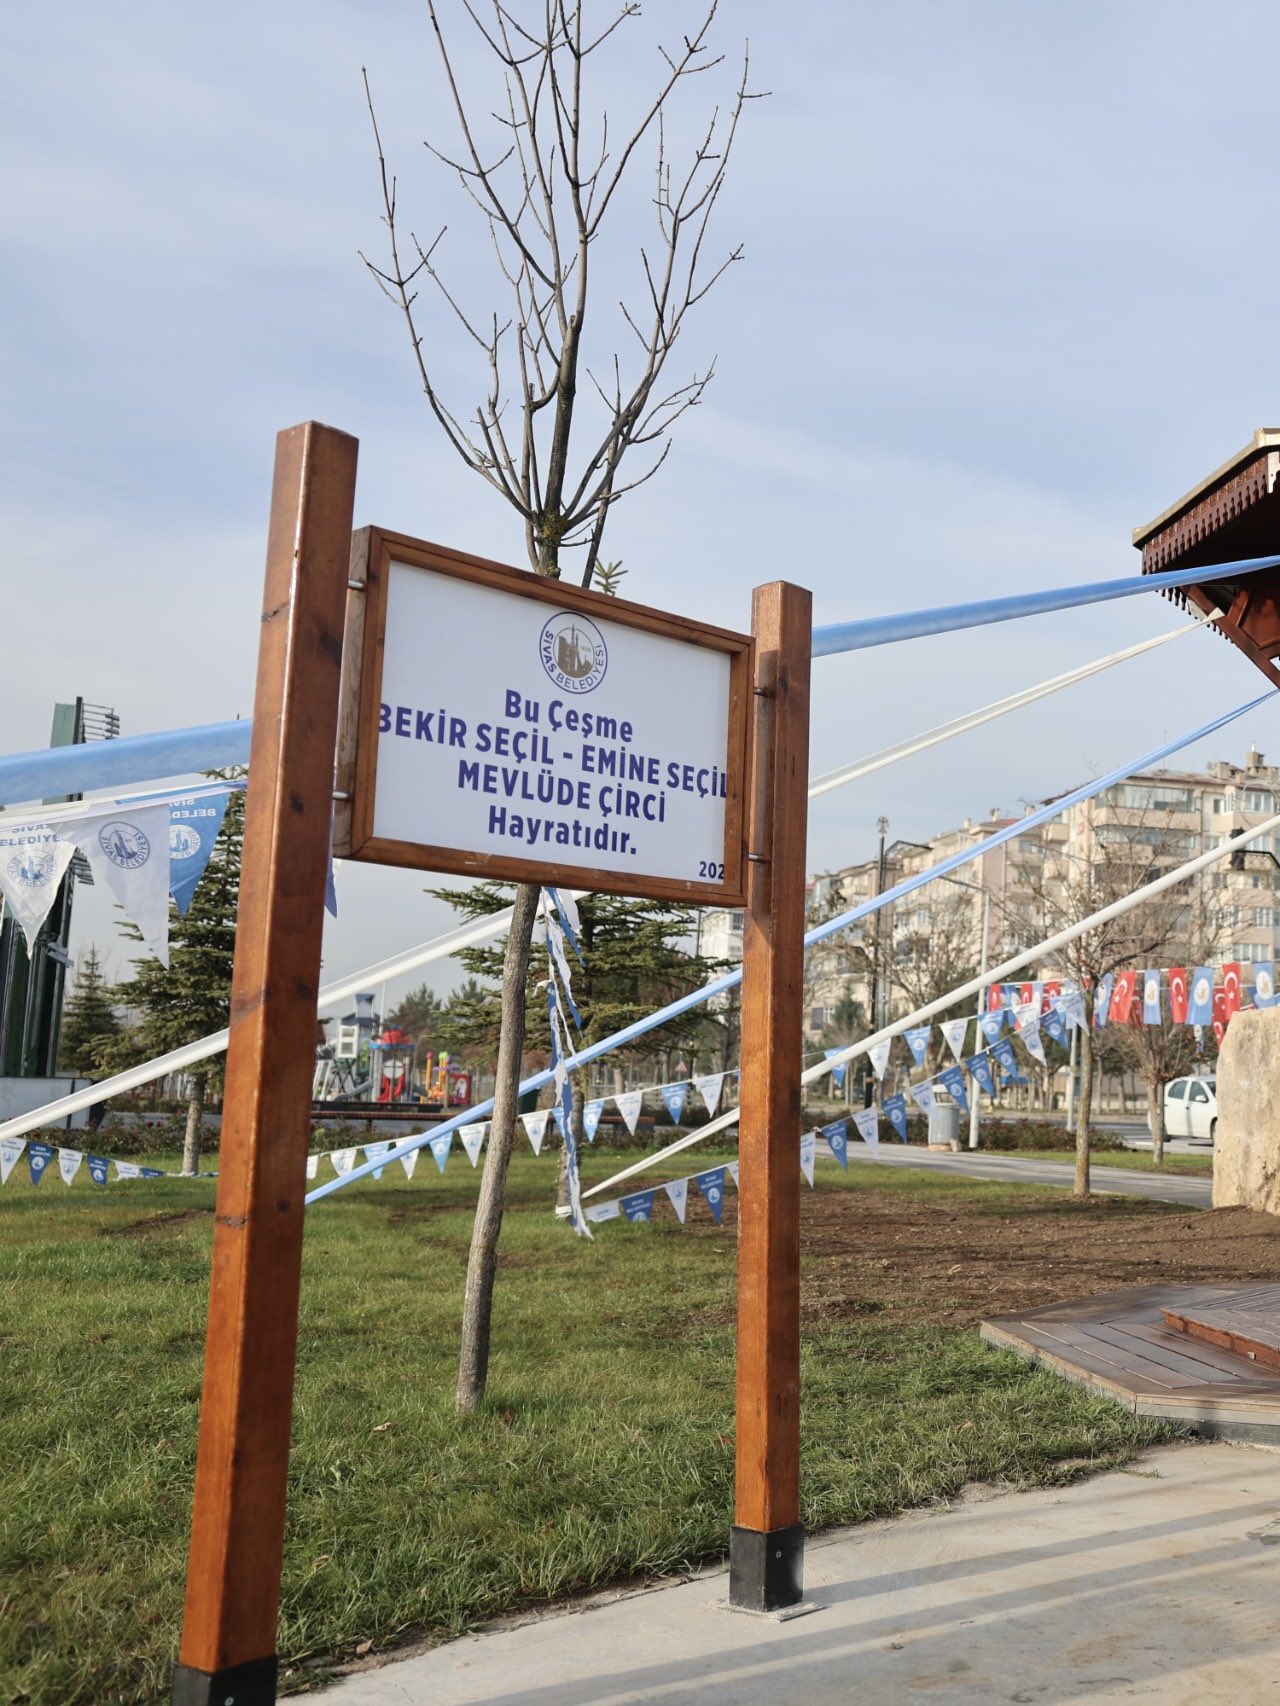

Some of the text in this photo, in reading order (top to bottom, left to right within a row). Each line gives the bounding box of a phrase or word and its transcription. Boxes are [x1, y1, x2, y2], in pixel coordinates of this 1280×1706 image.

[543, 631, 557, 673] SIVAS
[505, 689, 633, 743] Bu Çeşme
[378, 703, 467, 748] BEKİR
[475, 723, 554, 765] SEÇİL
[581, 744, 660, 785] EMİNE
[666, 762, 727, 798] SEÇİL
[458, 759, 665, 822] MEVLÜDE ÇİRCİ
[488, 805, 637, 855] Hayratıdır.
